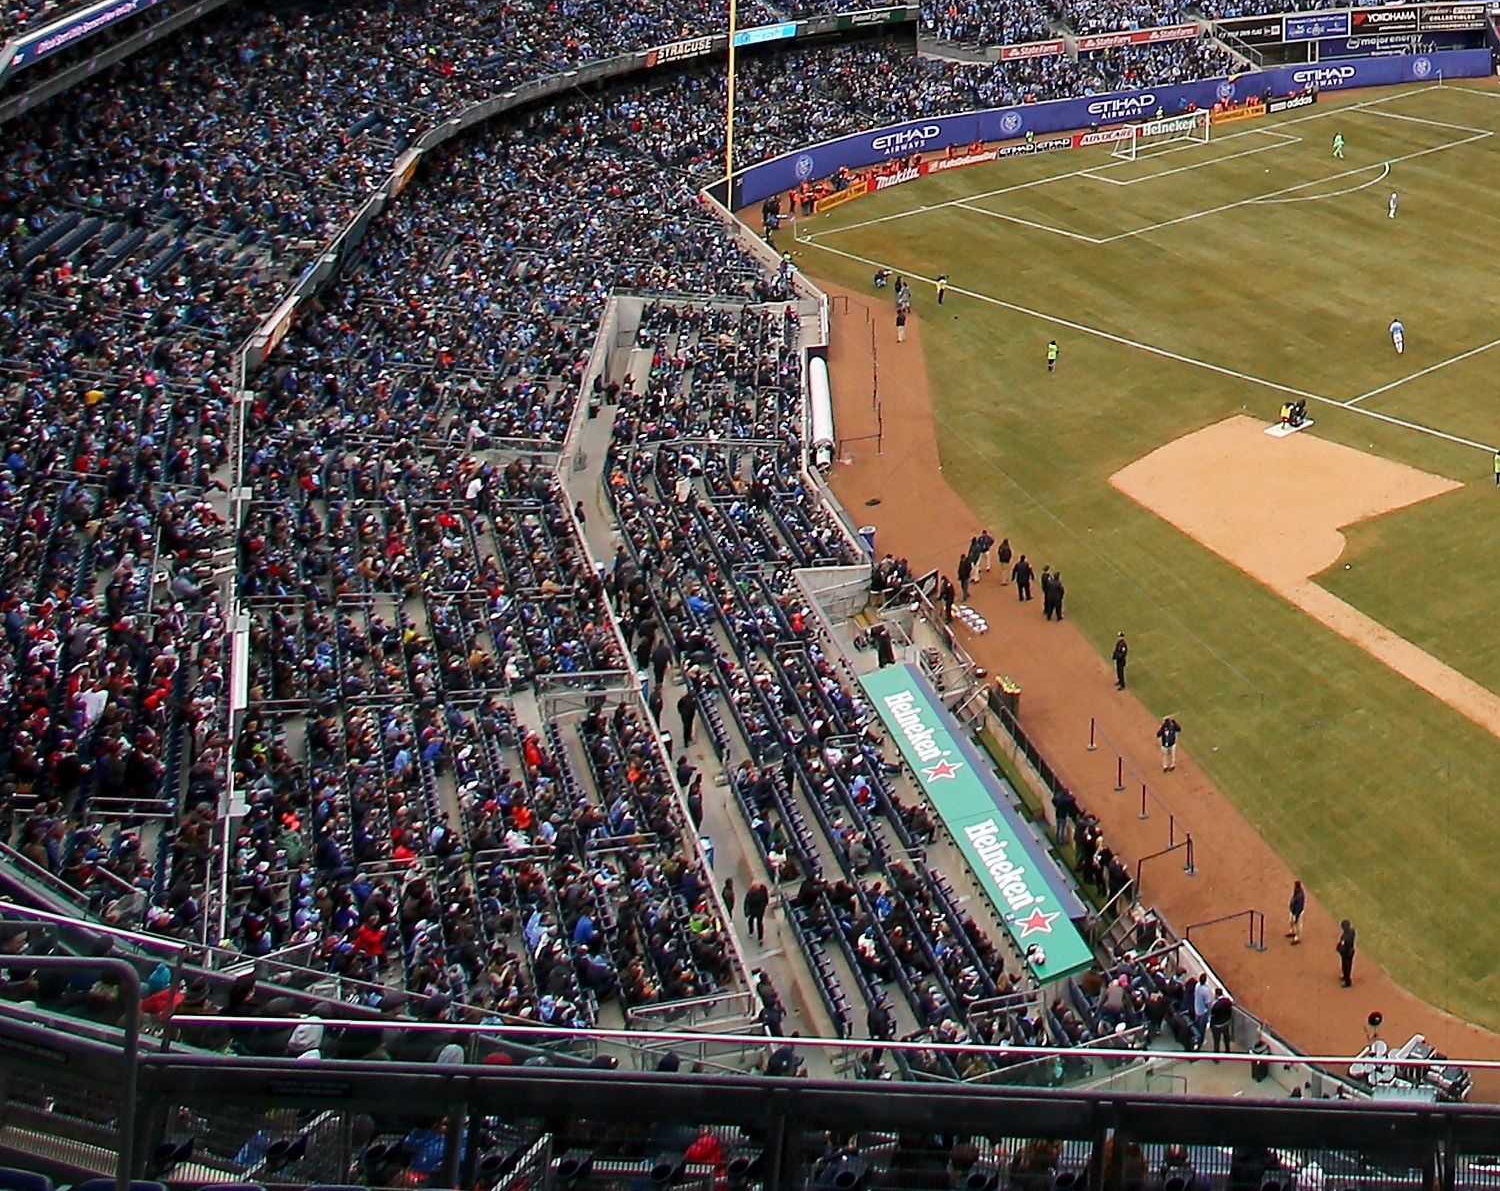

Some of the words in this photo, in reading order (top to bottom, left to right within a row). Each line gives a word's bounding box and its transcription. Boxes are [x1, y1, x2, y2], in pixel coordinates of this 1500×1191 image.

[1366, 10, 1416, 22] YOKOHAMA
[1429, 14, 1476, 22] COLLECTIBLES
[657, 38, 713, 60] SYRACUSE
[1293, 65, 1357, 83] ETIHAD
[1088, 94, 1157, 115] ETIHAD
[1287, 95, 1313, 109] adidas
[1101, 107, 1142, 120] AIRWAYS
[1141, 117, 1197, 138] Heineken
[872, 125, 940, 150] ETIHAD
[1037, 138, 1071, 149] ETIHAD
[884, 139, 926, 155] AIRWAYS
[1000, 143, 1035, 155] ETIHAD
[883, 688, 952, 761] Heineken
[962, 816, 1045, 911] Heineken
